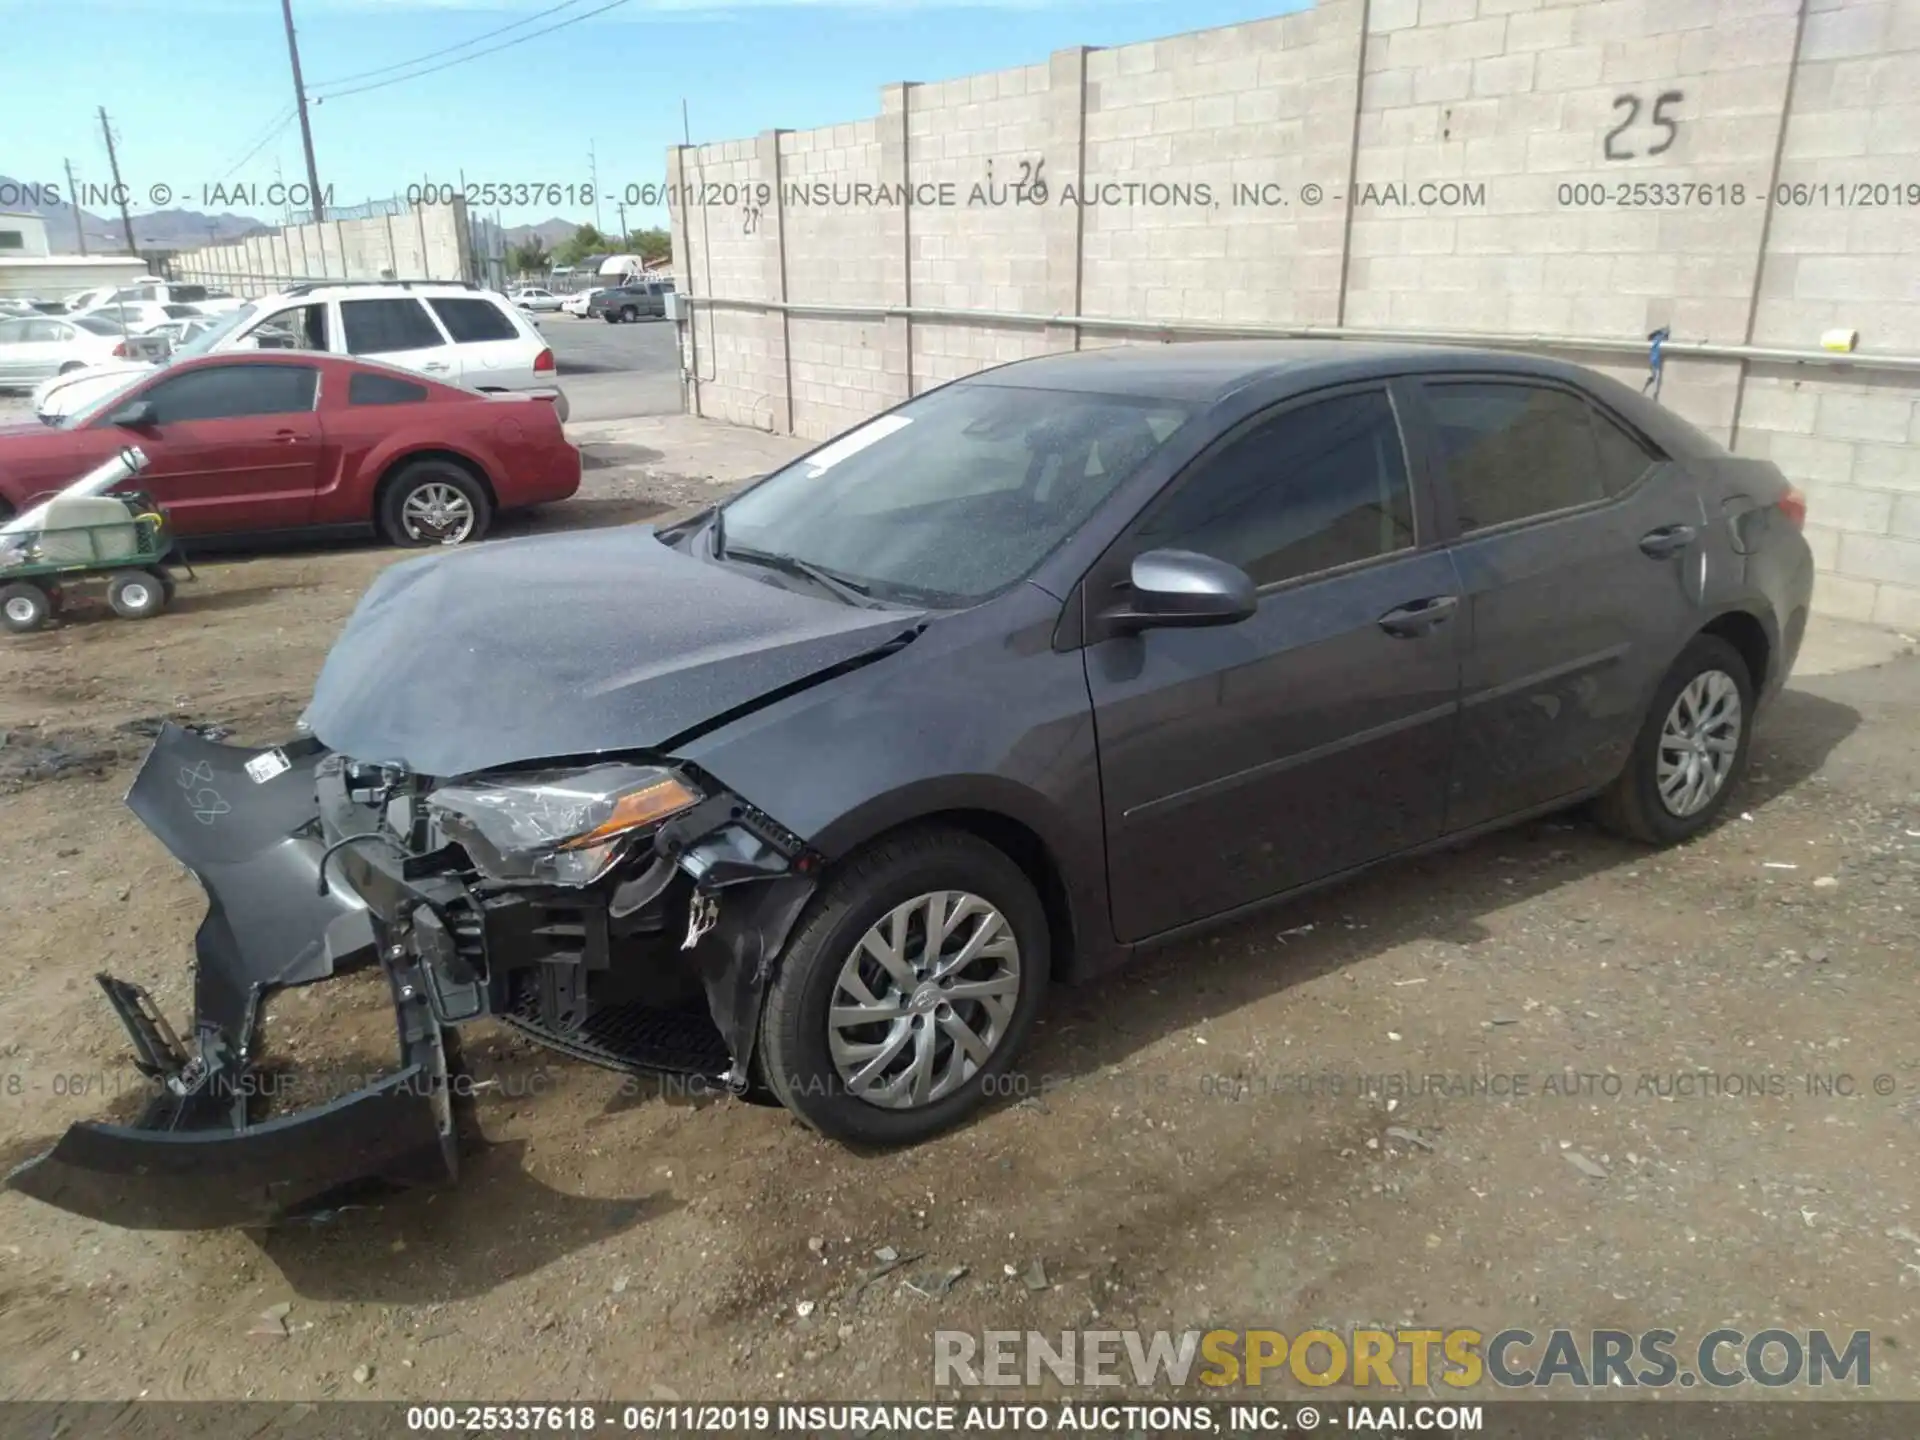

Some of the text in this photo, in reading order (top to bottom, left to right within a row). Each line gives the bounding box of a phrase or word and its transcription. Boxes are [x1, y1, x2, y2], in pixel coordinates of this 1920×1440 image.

[1604, 90, 1684, 160] 25
[1018, 157, 1048, 202] 26
[742, 206, 760, 235] 27
